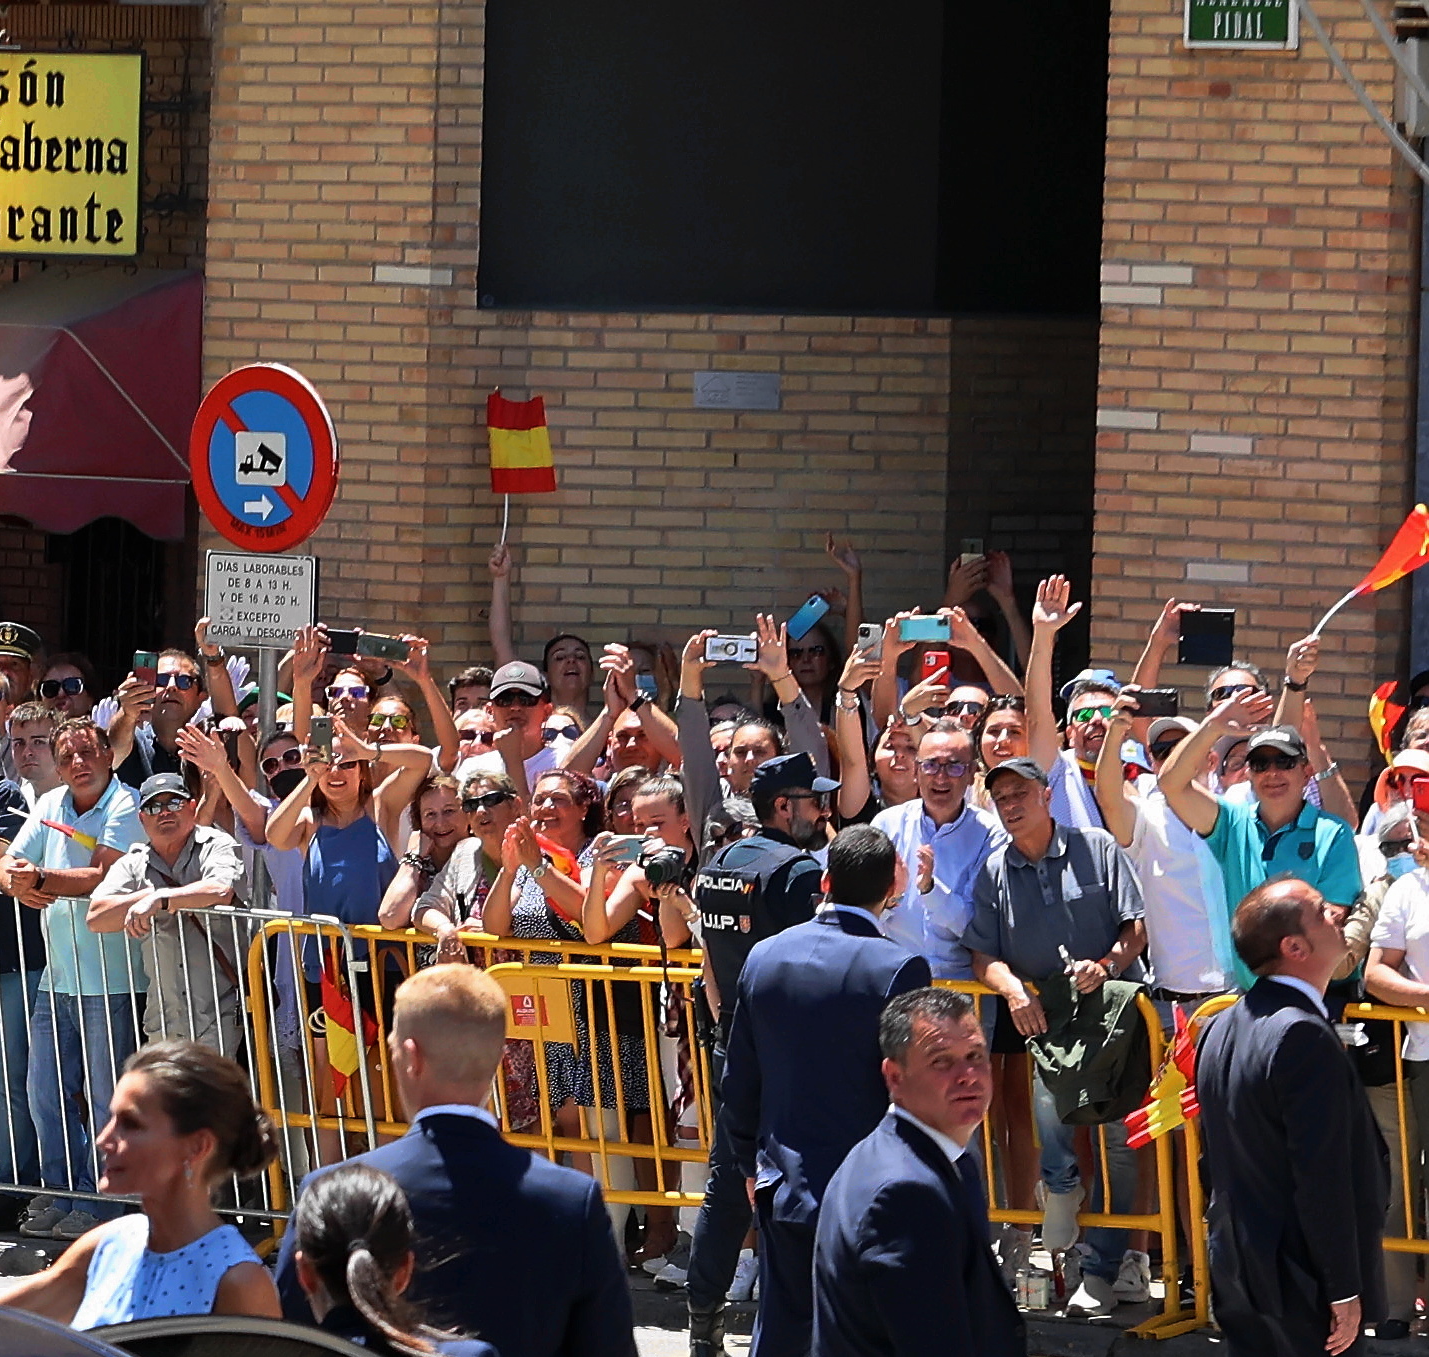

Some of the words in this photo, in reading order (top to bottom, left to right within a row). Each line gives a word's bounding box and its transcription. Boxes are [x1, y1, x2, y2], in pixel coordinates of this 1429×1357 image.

[1213, 11, 1263, 39] PIDAL
[243, 563, 304, 576] LABORABLES
[228, 577, 240, 588] DE
[244, 578, 251, 588] 8
[256, 579, 262, 589] A
[268, 580, 278, 590] 13
[282, 581, 292, 591] H.
[219, 592, 226, 602] Y
[230, 593, 243, 603] DE
[249, 594, 259, 604] 16
[263, 595, 270, 605] A
[275, 595, 286, 605] 20
[290, 596, 300, 606] H.
[237, 611, 281, 623] EXCEPTO
[210, 625, 241, 636] CARGA
[246, 627, 252, 637] Y
[697, 874, 744, 891] POLICIA
[702, 912, 739, 931] U.I.P.
